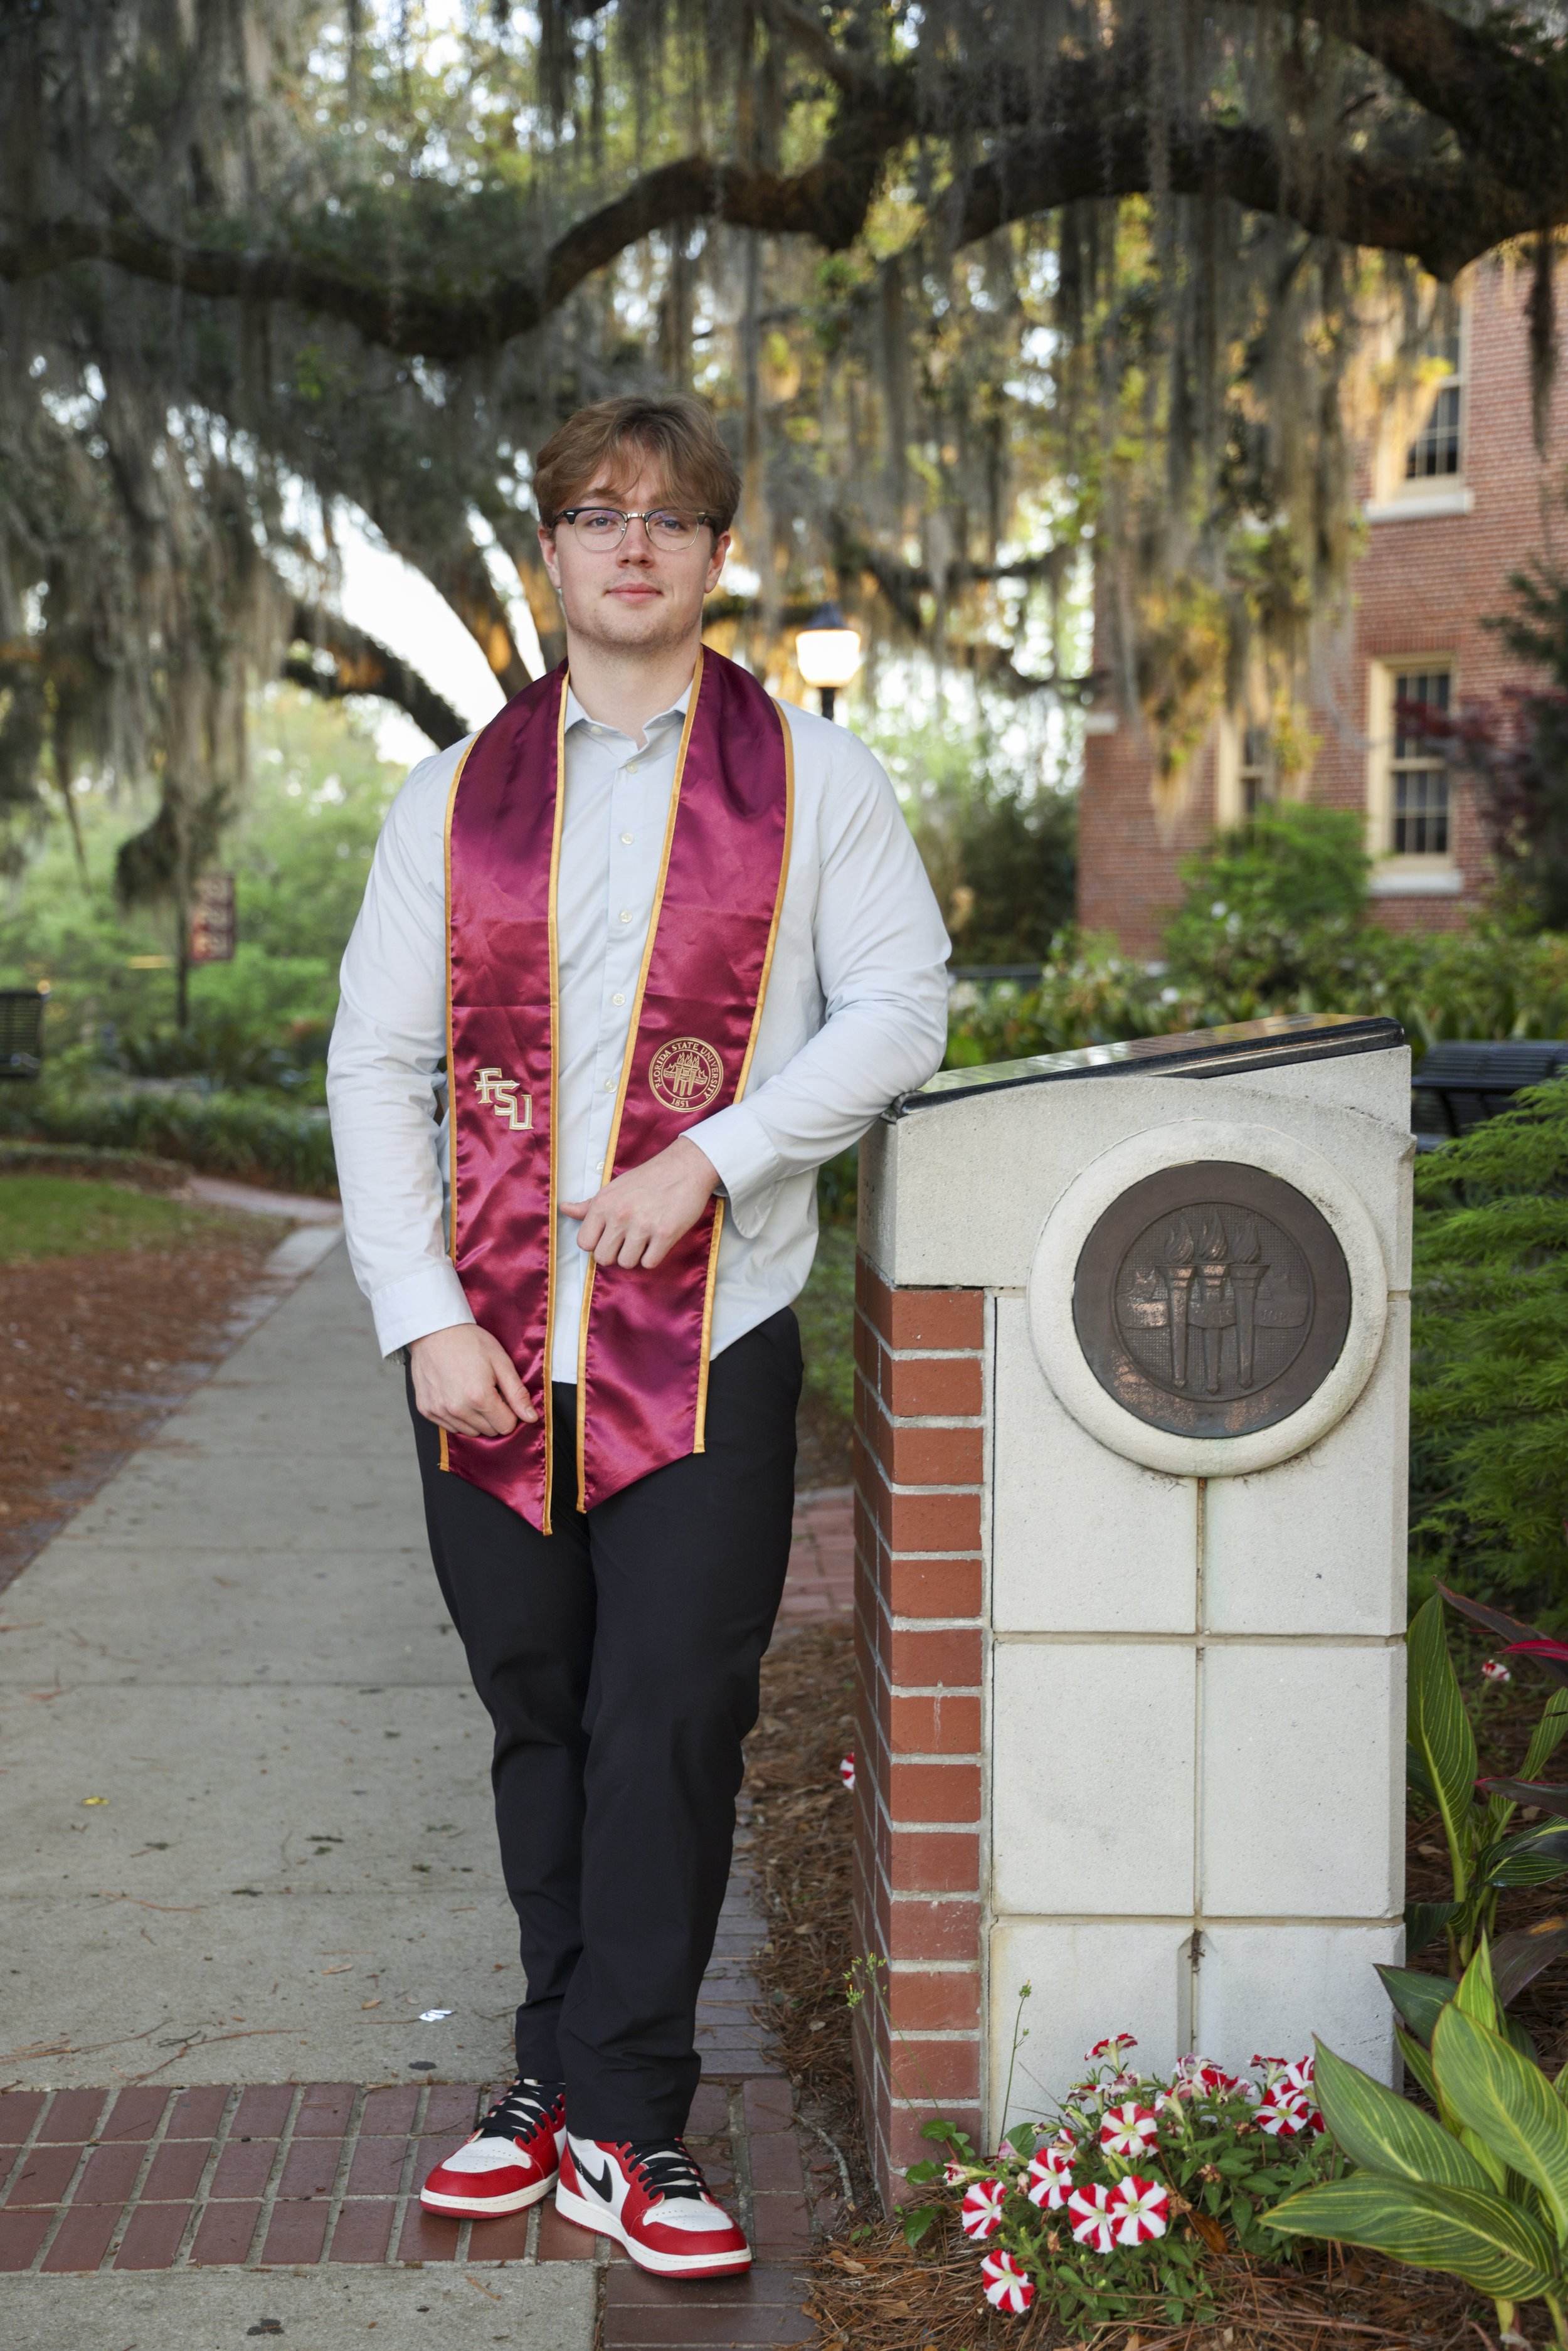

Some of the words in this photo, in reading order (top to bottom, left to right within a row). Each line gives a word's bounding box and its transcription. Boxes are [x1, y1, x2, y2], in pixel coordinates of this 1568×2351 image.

[474, 1068, 534, 1130] FSU
[654, 1049, 671, 1088] FLORIDA
[671, 1042, 699, 1051] STATE
[701, 1048, 718, 1099] UNIVERSITY
[670, 1098, 689, 1108] 1851
